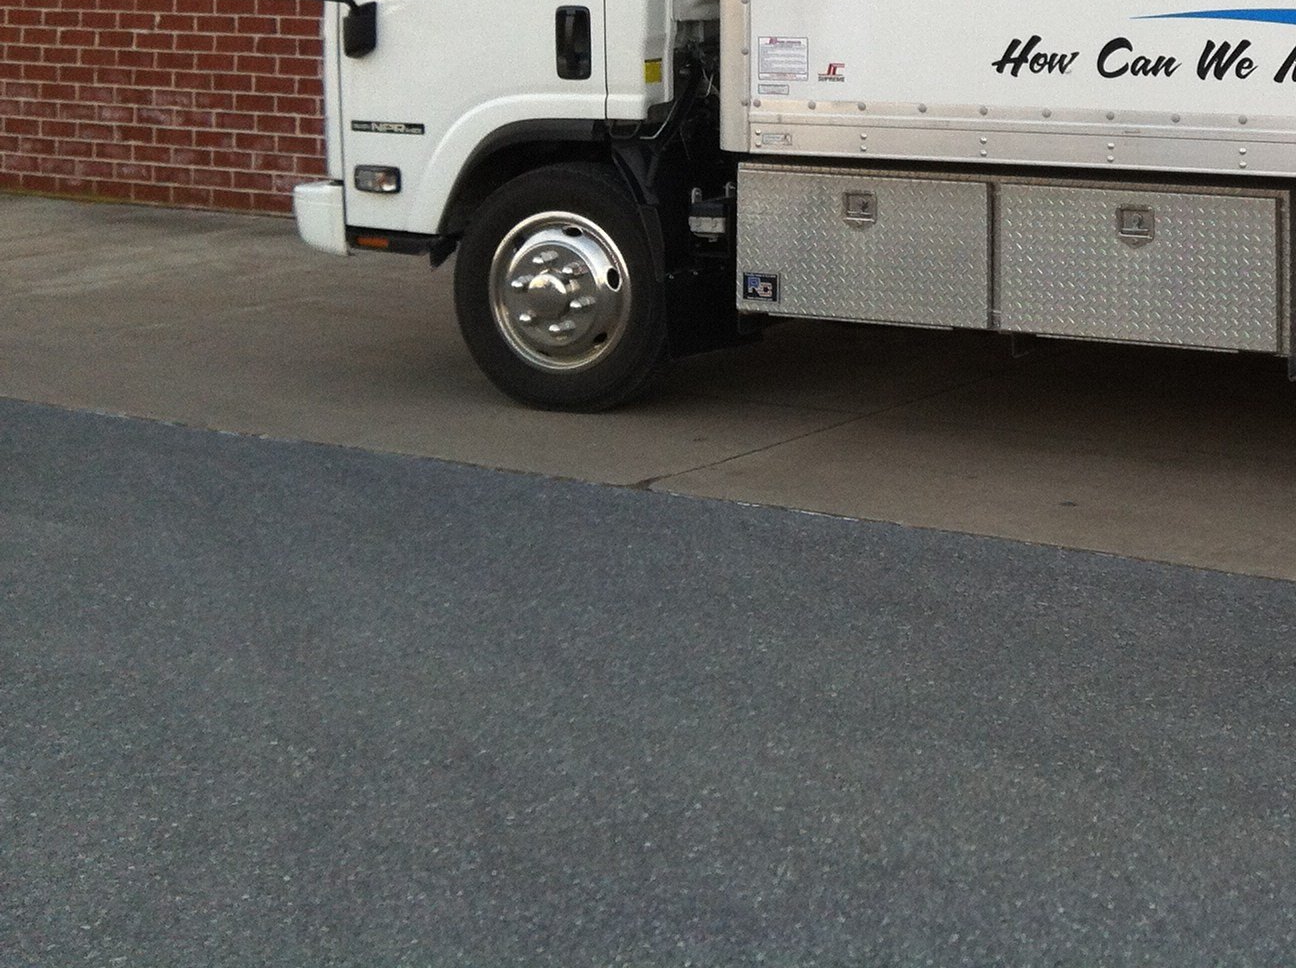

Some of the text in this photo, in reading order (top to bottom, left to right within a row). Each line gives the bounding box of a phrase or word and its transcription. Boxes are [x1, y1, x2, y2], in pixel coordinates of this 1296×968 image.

[991, 34, 1080, 78] How
[1096, 37, 1182, 80] Can
[1196, 39, 1258, 81] We
